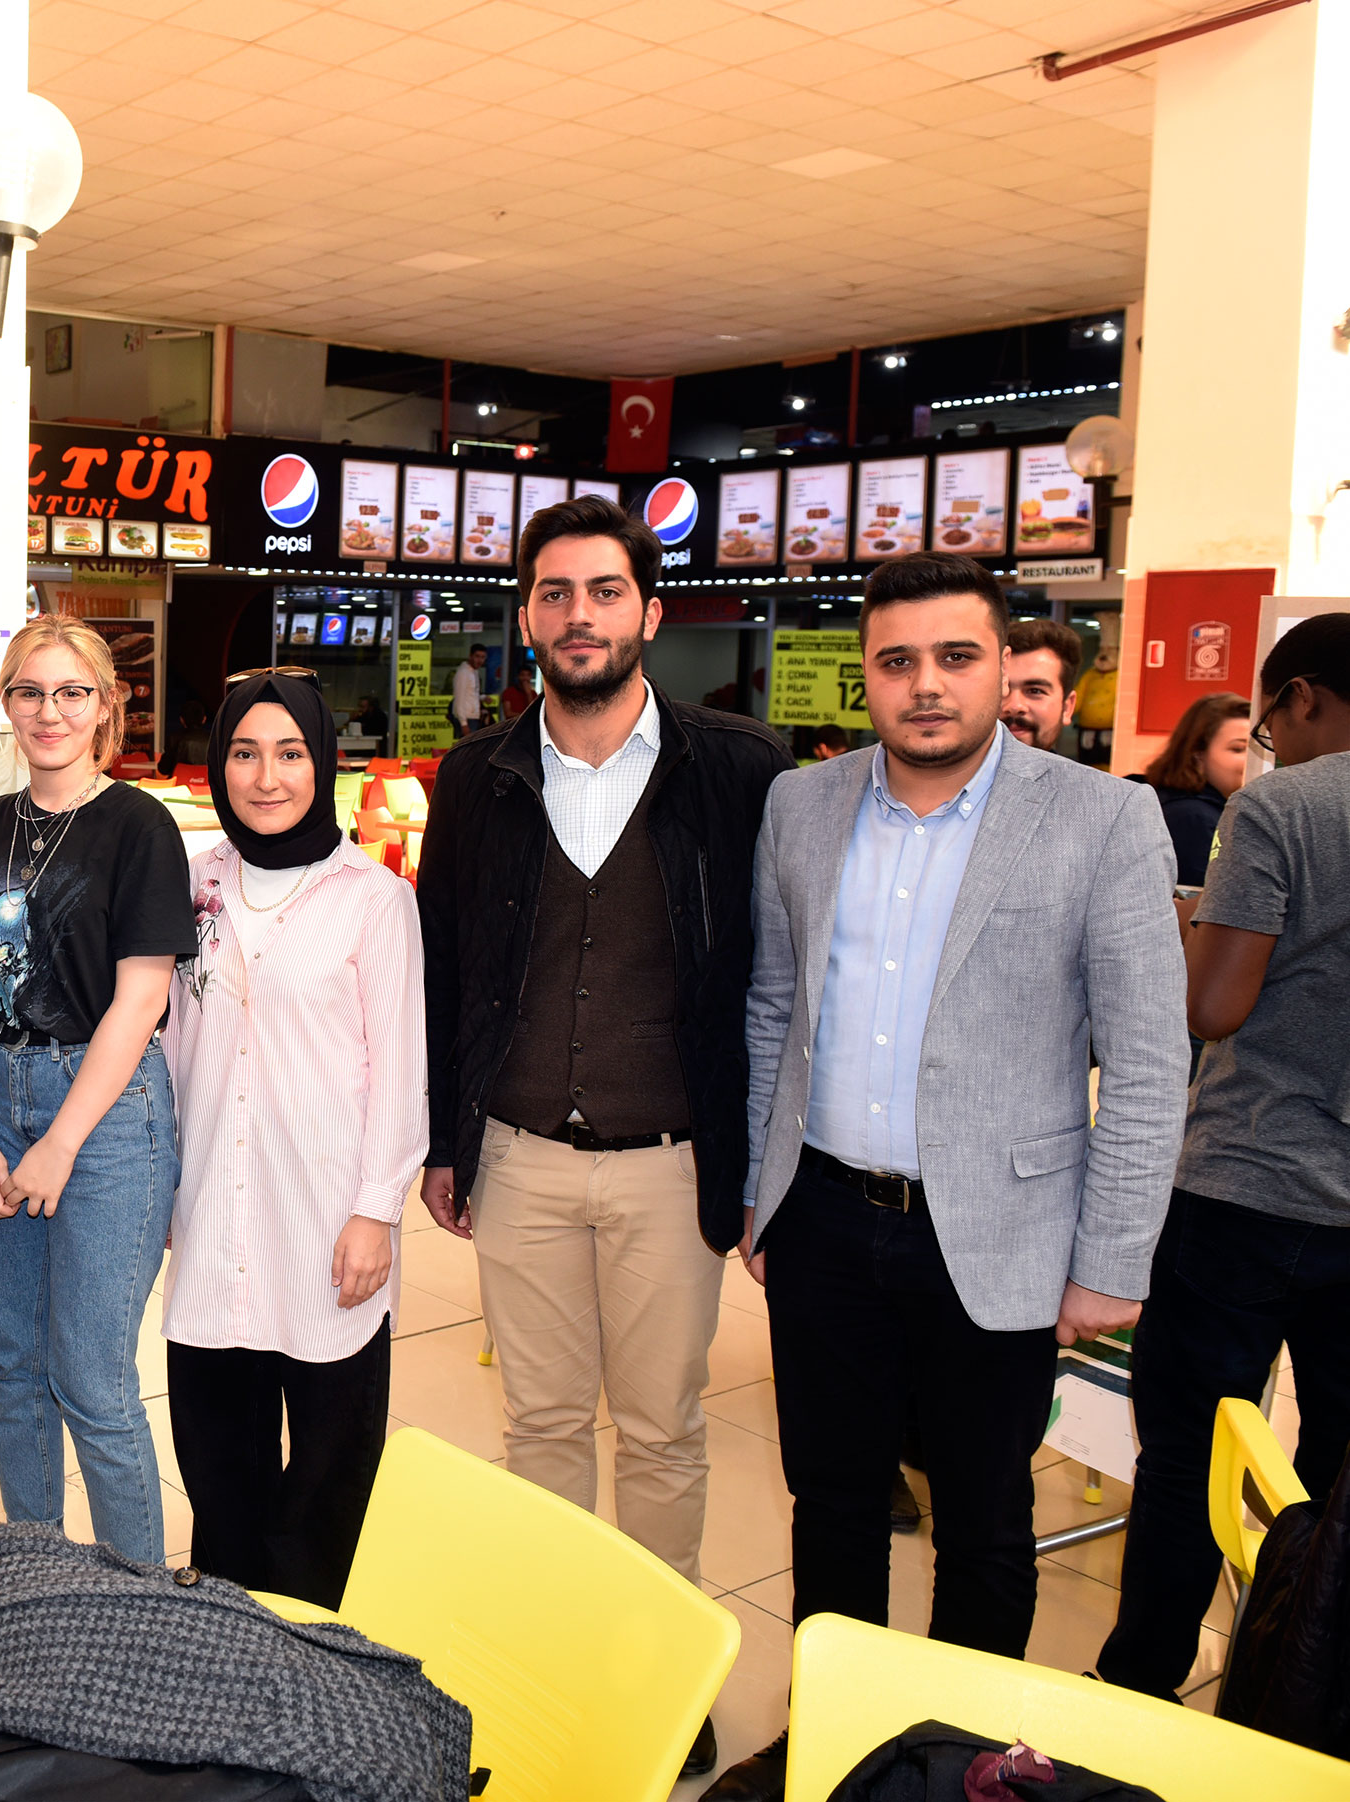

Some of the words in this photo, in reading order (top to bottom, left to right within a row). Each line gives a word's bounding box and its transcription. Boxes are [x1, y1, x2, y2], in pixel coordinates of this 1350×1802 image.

[265, 534, 312, 556] pepsi
[1022, 565, 1096, 578] RESTAURANT
[399, 676, 416, 697] 12
